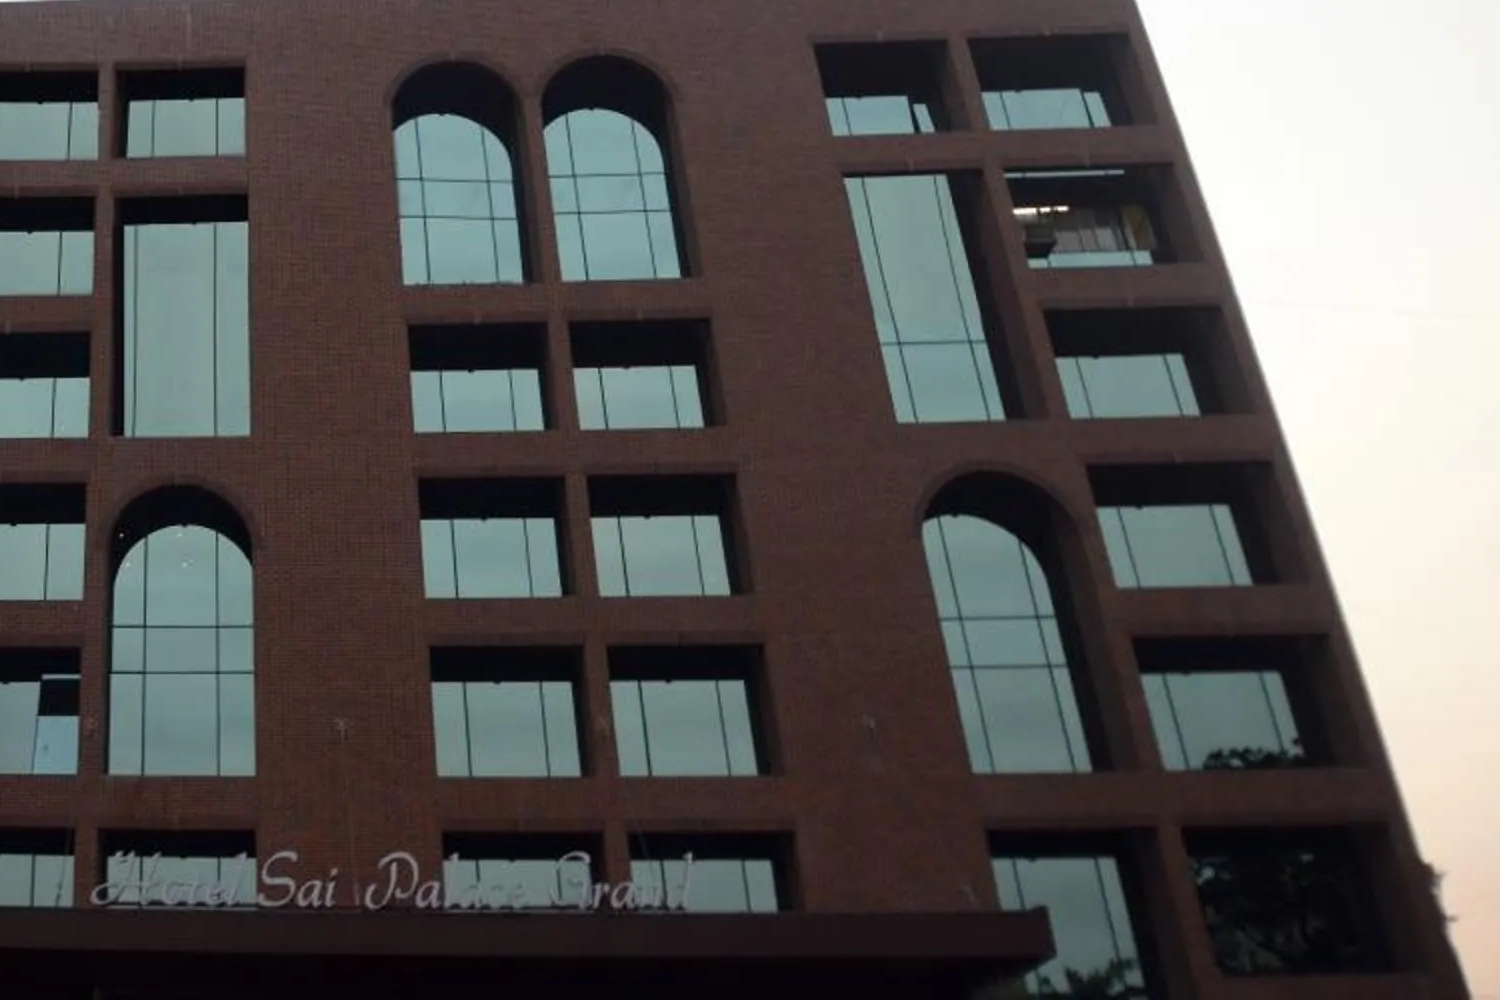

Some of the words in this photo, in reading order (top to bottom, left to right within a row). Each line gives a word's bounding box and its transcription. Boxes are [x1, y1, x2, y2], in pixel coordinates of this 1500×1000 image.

[257, 848, 337, 908] Sai
[364, 850, 529, 910] Palace
[549, 850, 695, 910] Grand
